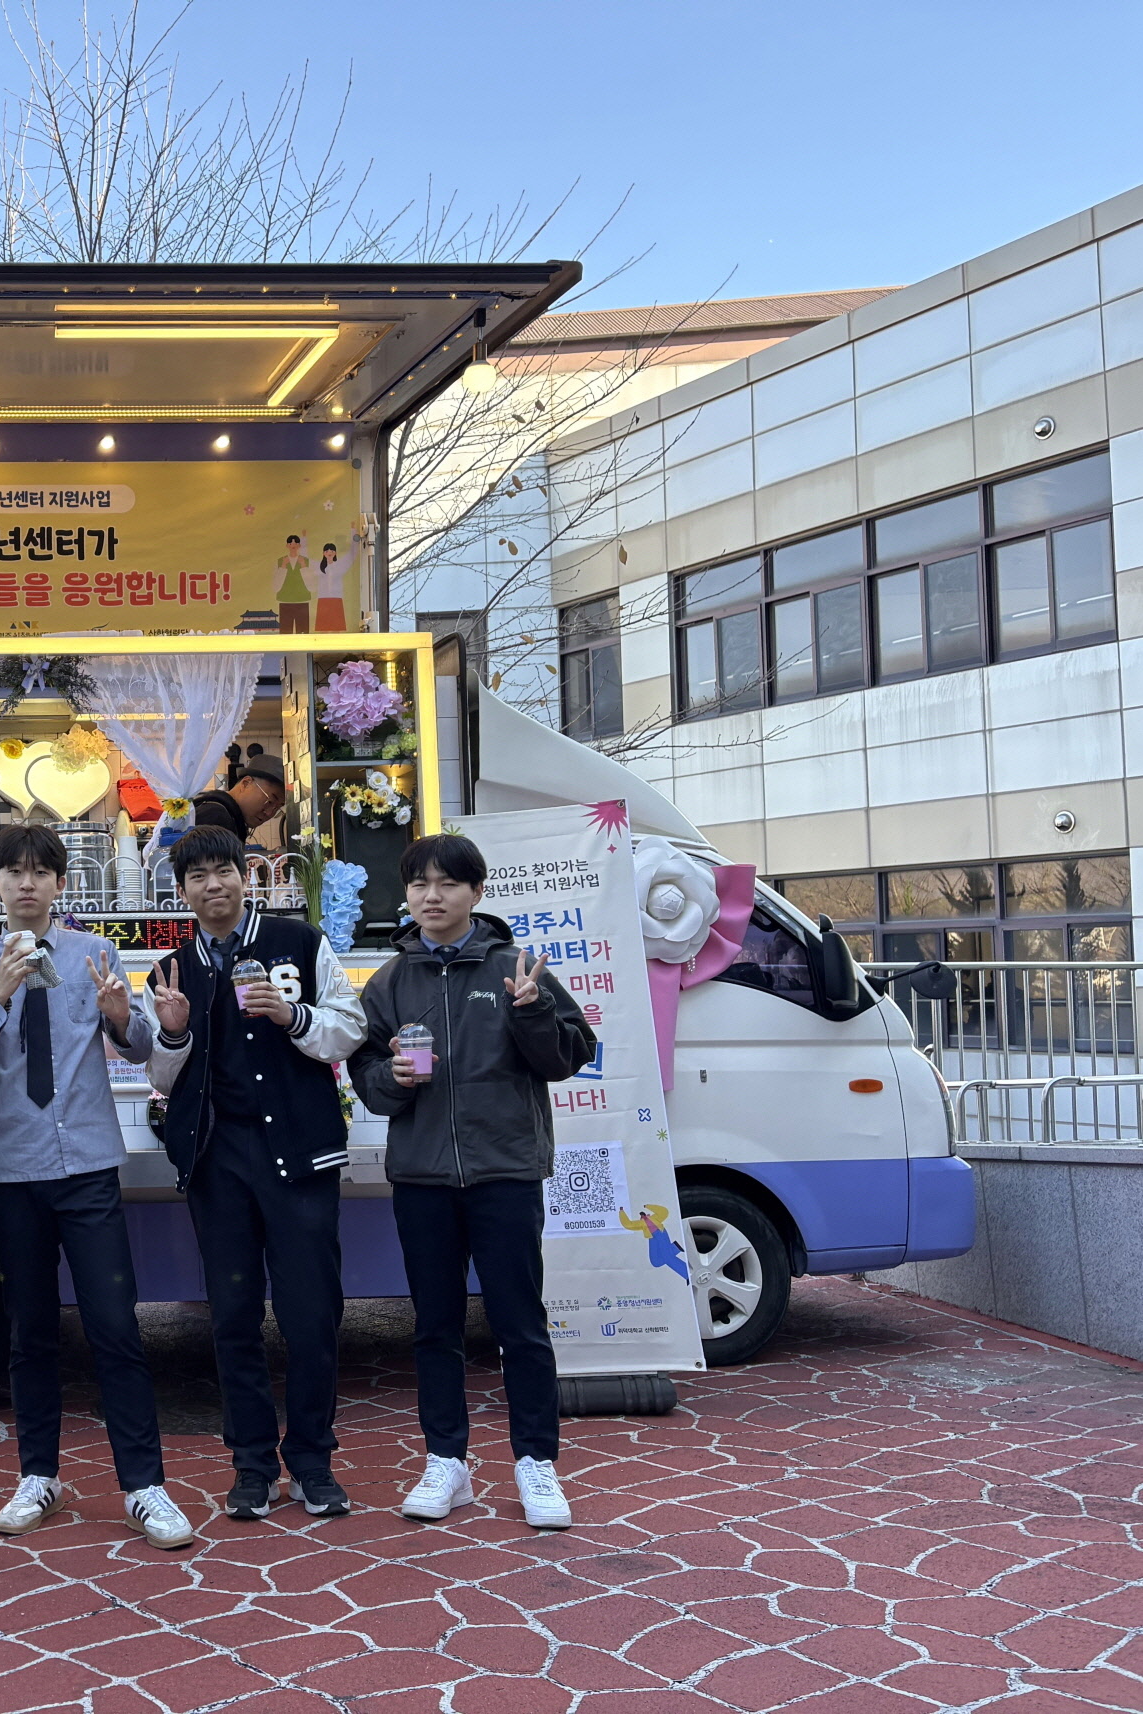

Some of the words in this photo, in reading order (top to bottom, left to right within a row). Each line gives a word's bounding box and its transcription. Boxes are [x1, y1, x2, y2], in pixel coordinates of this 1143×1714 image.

[48, 490, 111, 508] 지원사업
[61, 570, 231, 607] 응원합니다!
[488, 865, 528, 880] 2025
[532, 859, 589, 877] 찾아가는
[483, 880, 538, 899] 청년센터
[543, 873, 600, 892] 지원사업
[508, 907, 584, 938] 경주시
[569, 972, 615, 996] 미래
